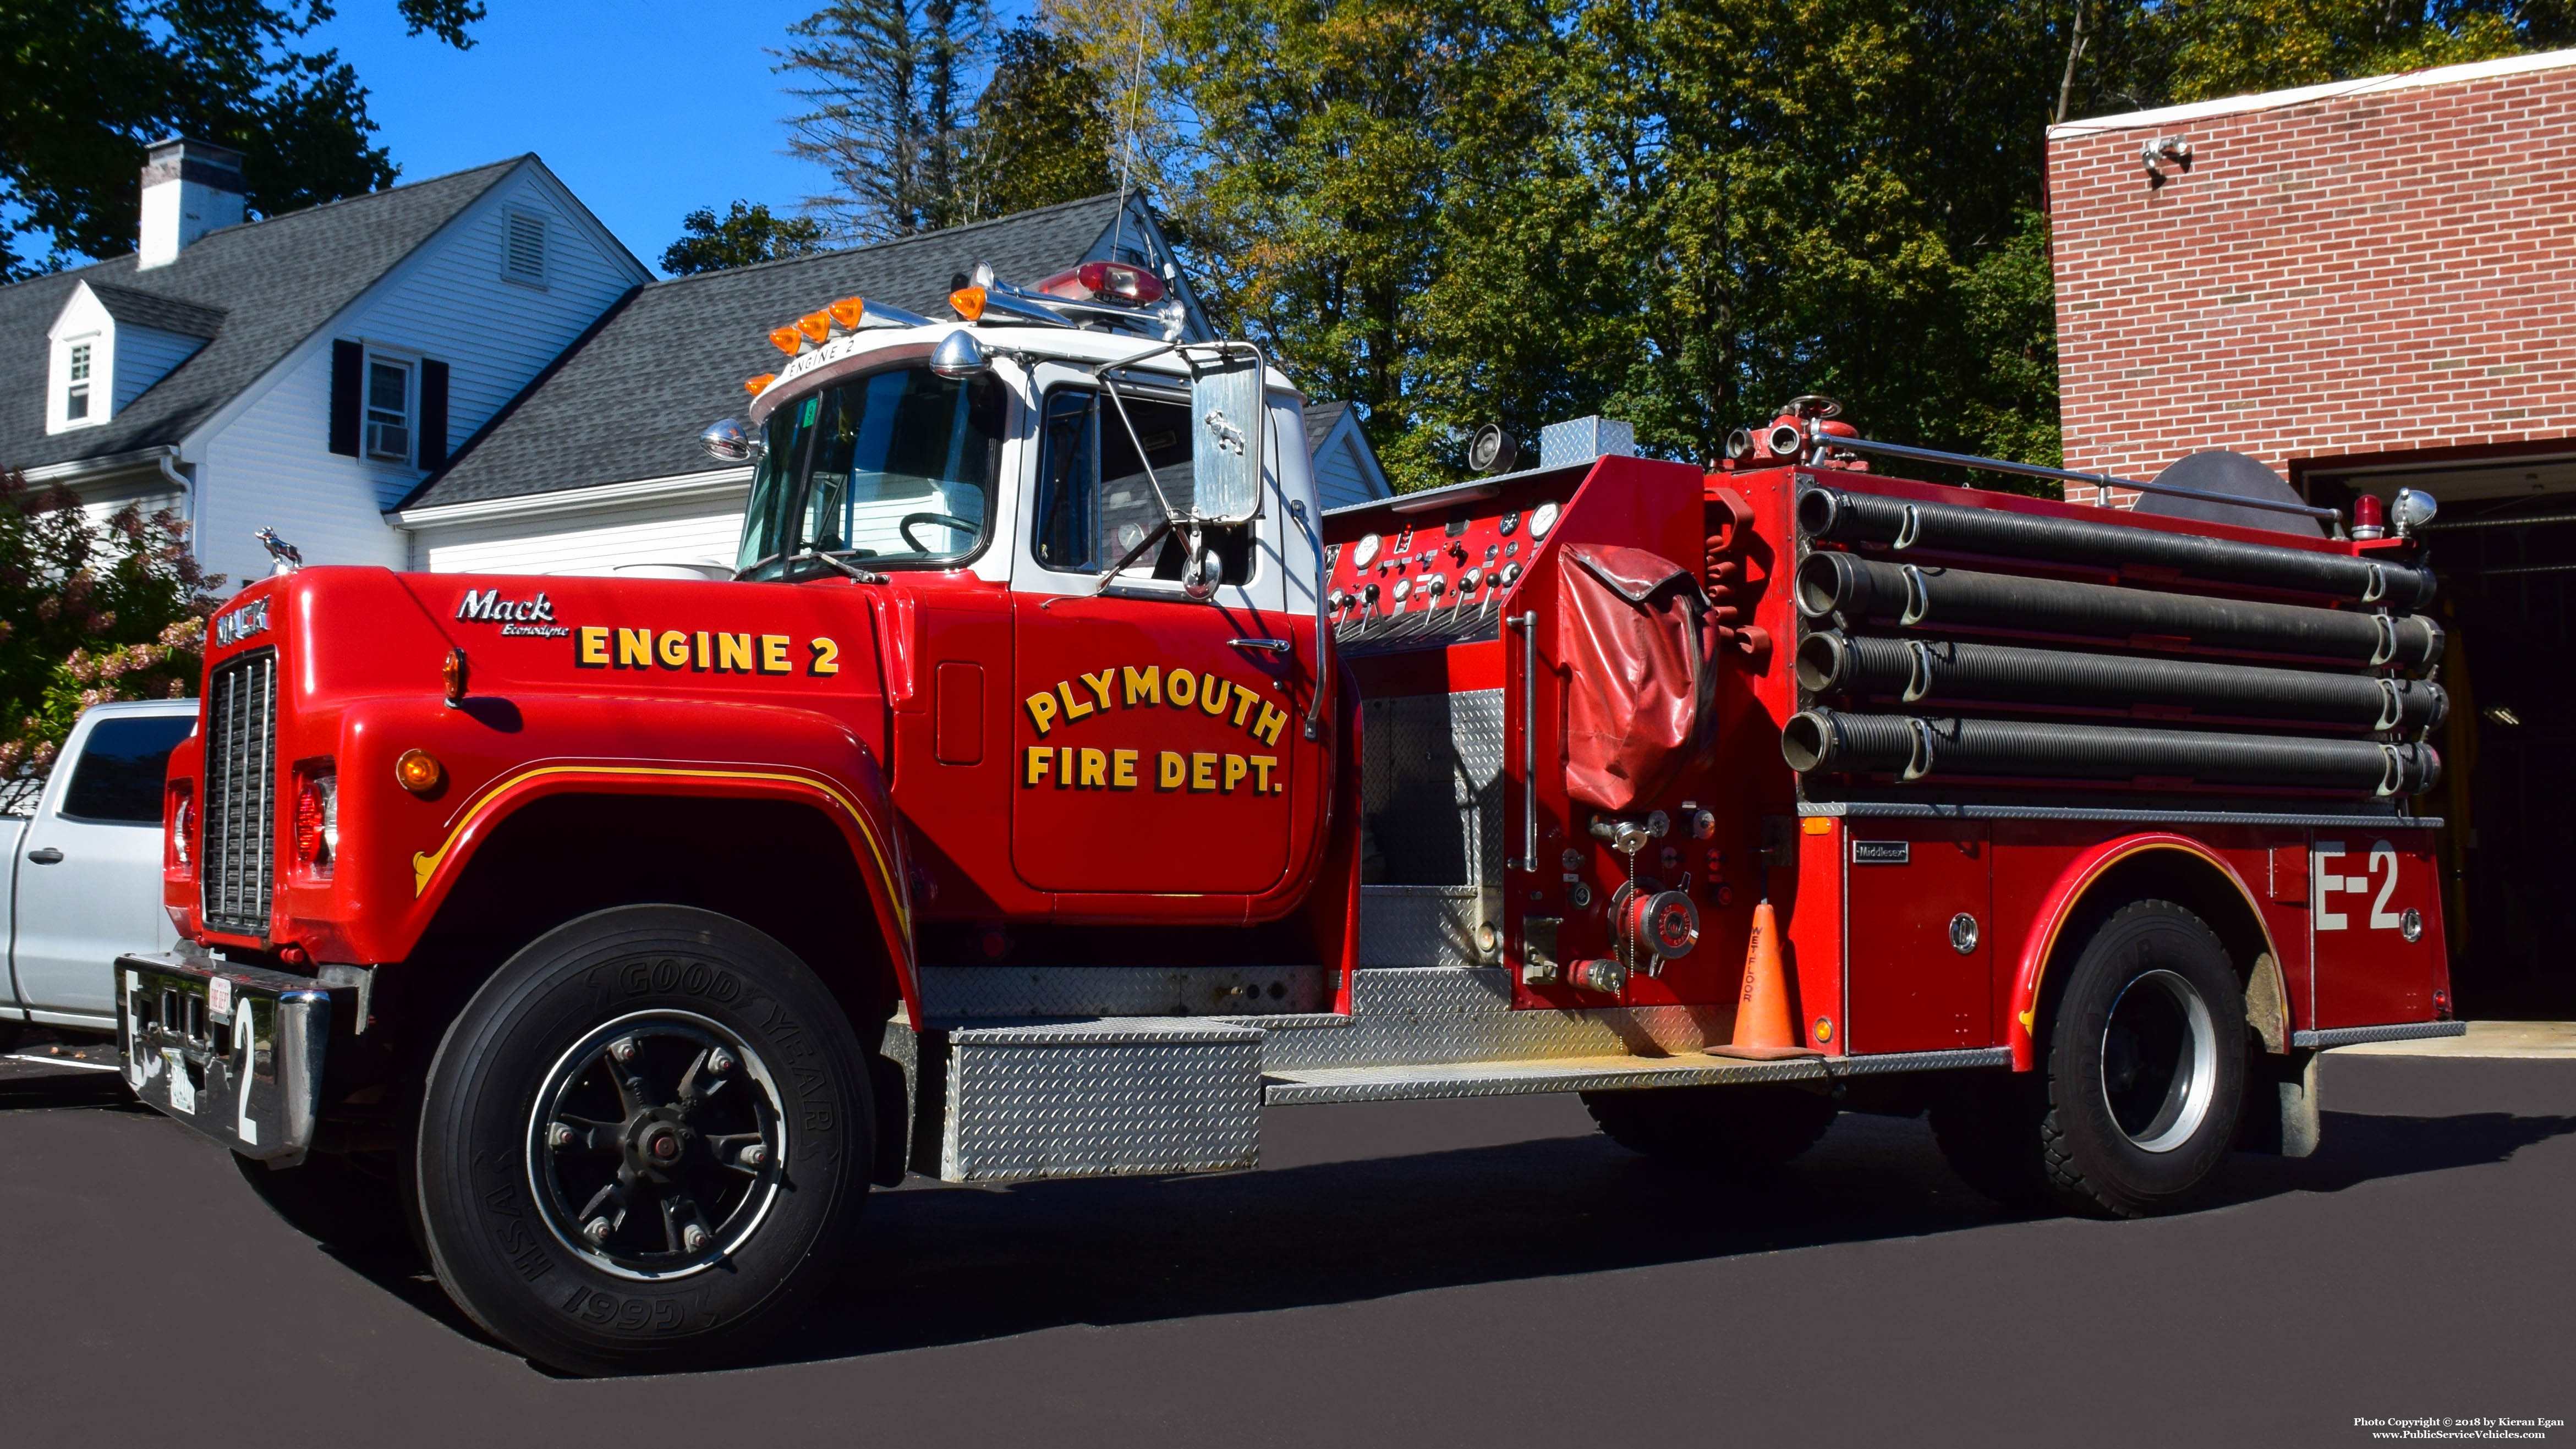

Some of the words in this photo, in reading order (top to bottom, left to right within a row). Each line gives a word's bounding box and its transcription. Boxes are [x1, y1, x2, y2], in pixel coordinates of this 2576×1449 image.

[790, 346, 837, 377] ENGINE
[846, 340, 854, 353] 2
[456, 589, 554, 621] Mack
[501, 623, 569, 638] Econodyne
[580, 626, 792, 672] ENGINE
[810, 637, 839, 673] 2
[1026, 665, 1288, 747] PLYMOUTH
[1027, 746, 1138, 787] FIRE
[1160, 750, 1282, 792] DEPT.
[1860, 846, 1902, 857] Middlesex
[2315, 839, 2399, 930] E-2
[1751, 926, 1763, 953] WET
[1743, 956, 1756, 1002] FLOOR
[235, 997, 257, 1145] 2
